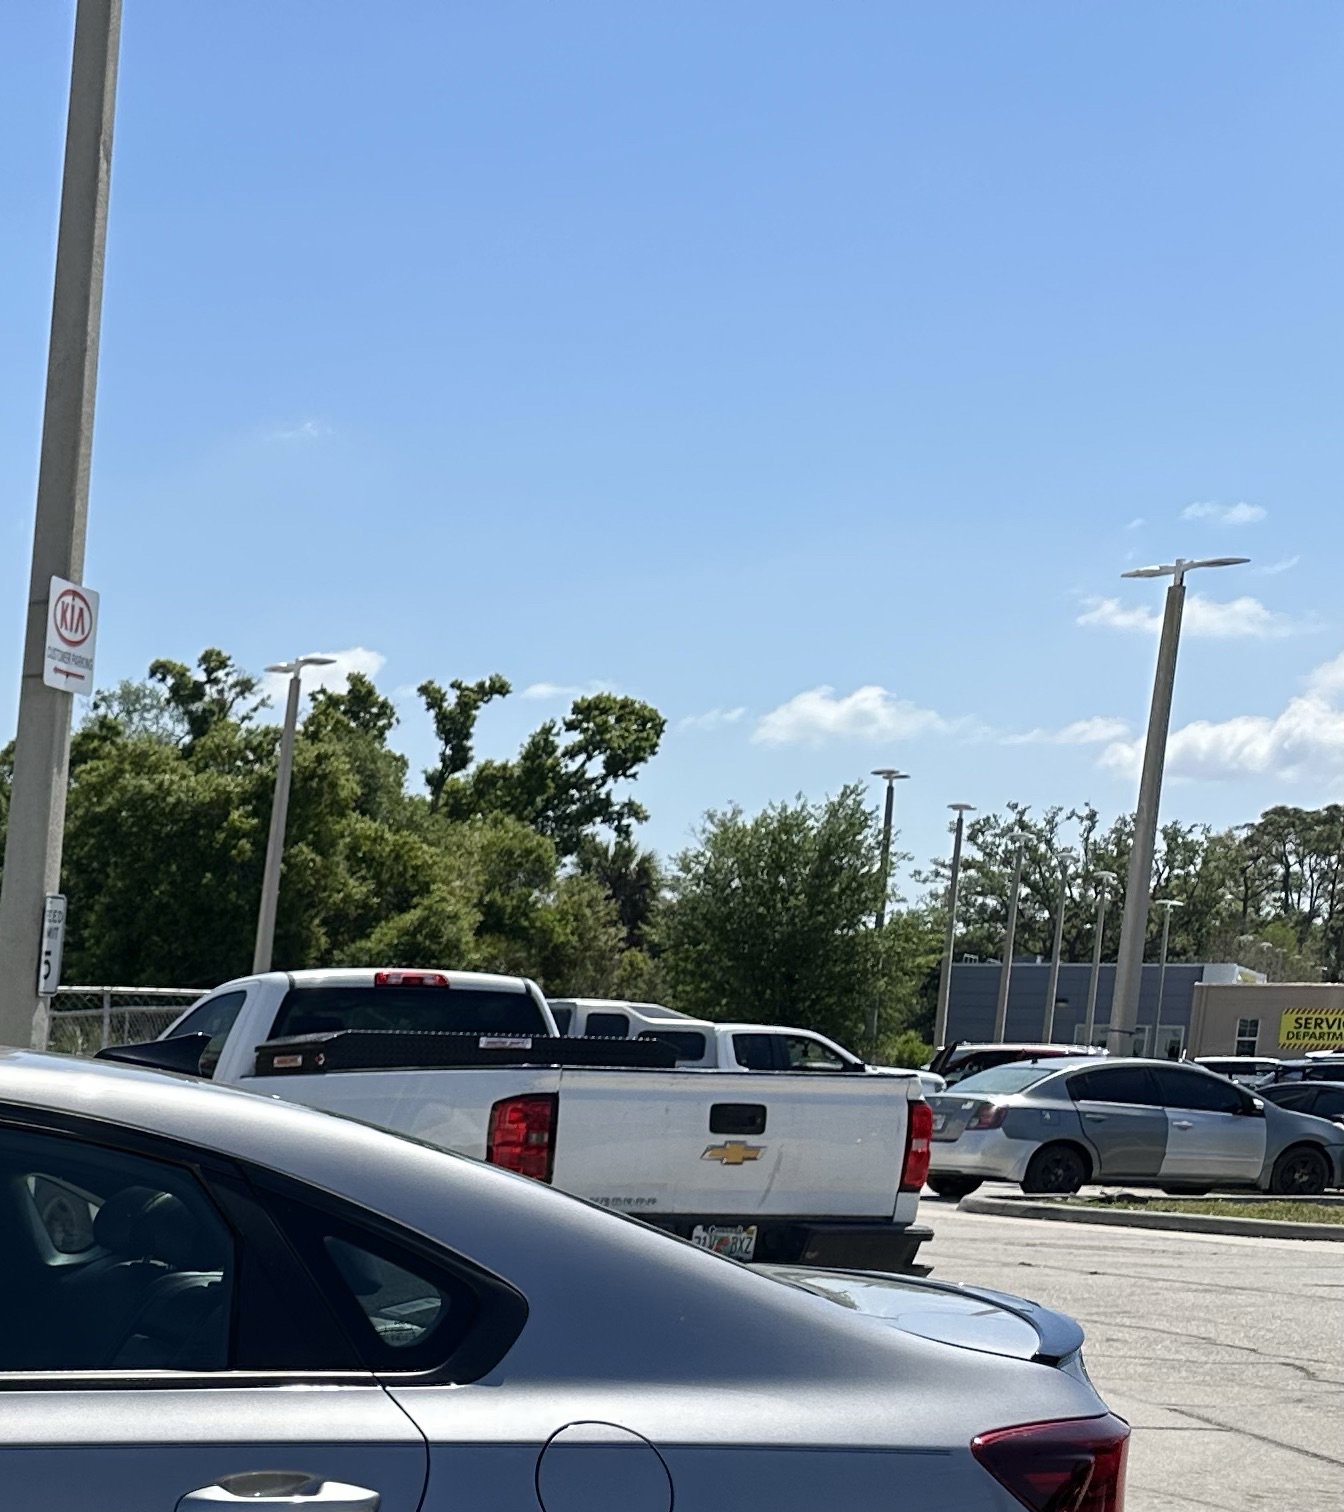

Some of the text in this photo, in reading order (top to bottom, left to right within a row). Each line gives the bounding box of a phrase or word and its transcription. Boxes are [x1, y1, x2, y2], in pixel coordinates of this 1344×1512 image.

[60, 600, 85, 636] KIA
[1293, 1016, 1344, 1030] SERVI
[1286, 1030, 1344, 1042] DEPARTM
